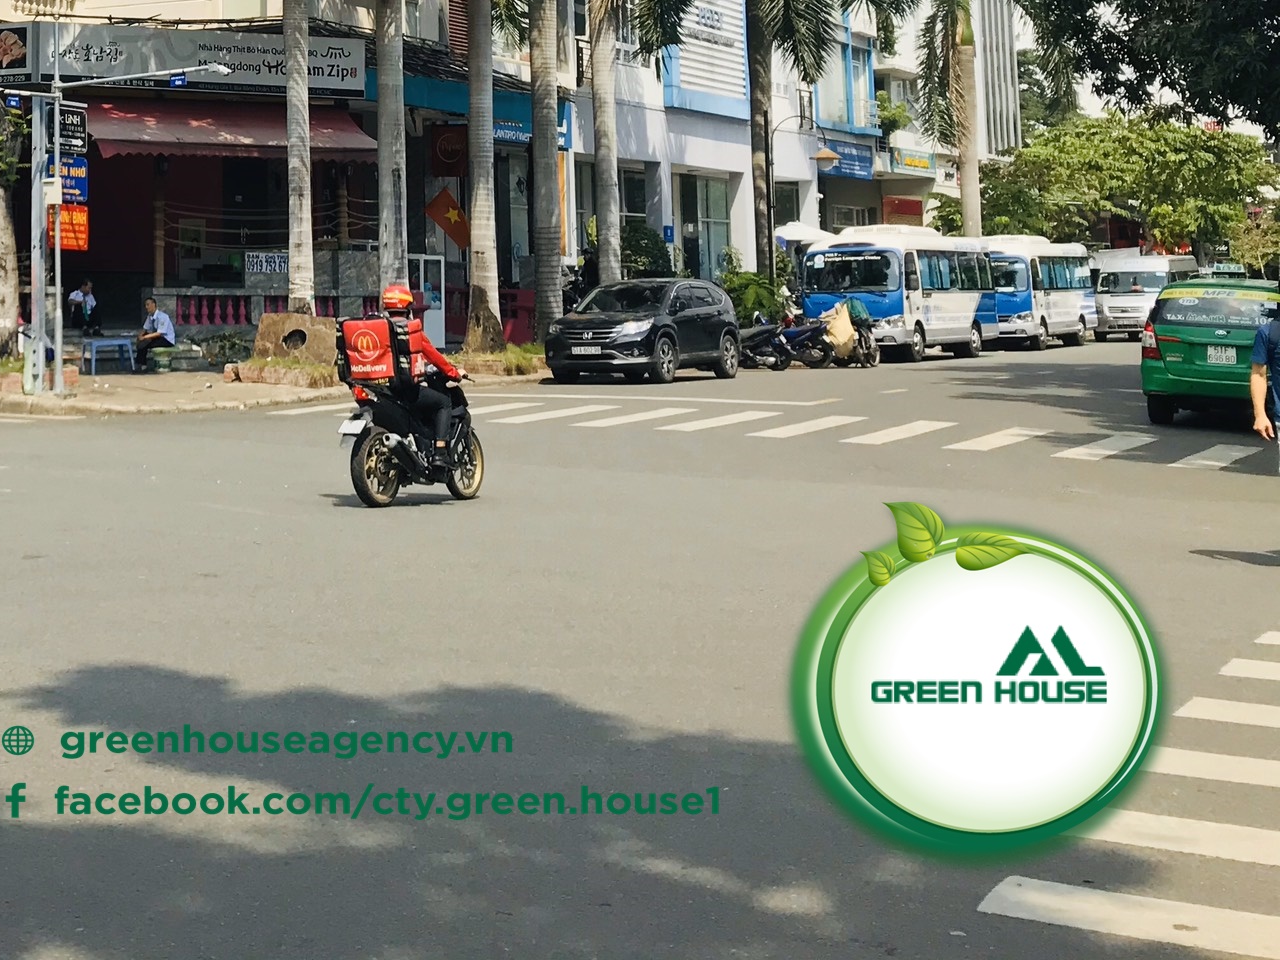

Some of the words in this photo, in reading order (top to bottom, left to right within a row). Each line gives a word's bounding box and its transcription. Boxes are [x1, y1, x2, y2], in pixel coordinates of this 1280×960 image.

[327, 64, 350, 81] Zip
[246, 260, 263, 272] 0919
[265, 260, 277, 273] 752
